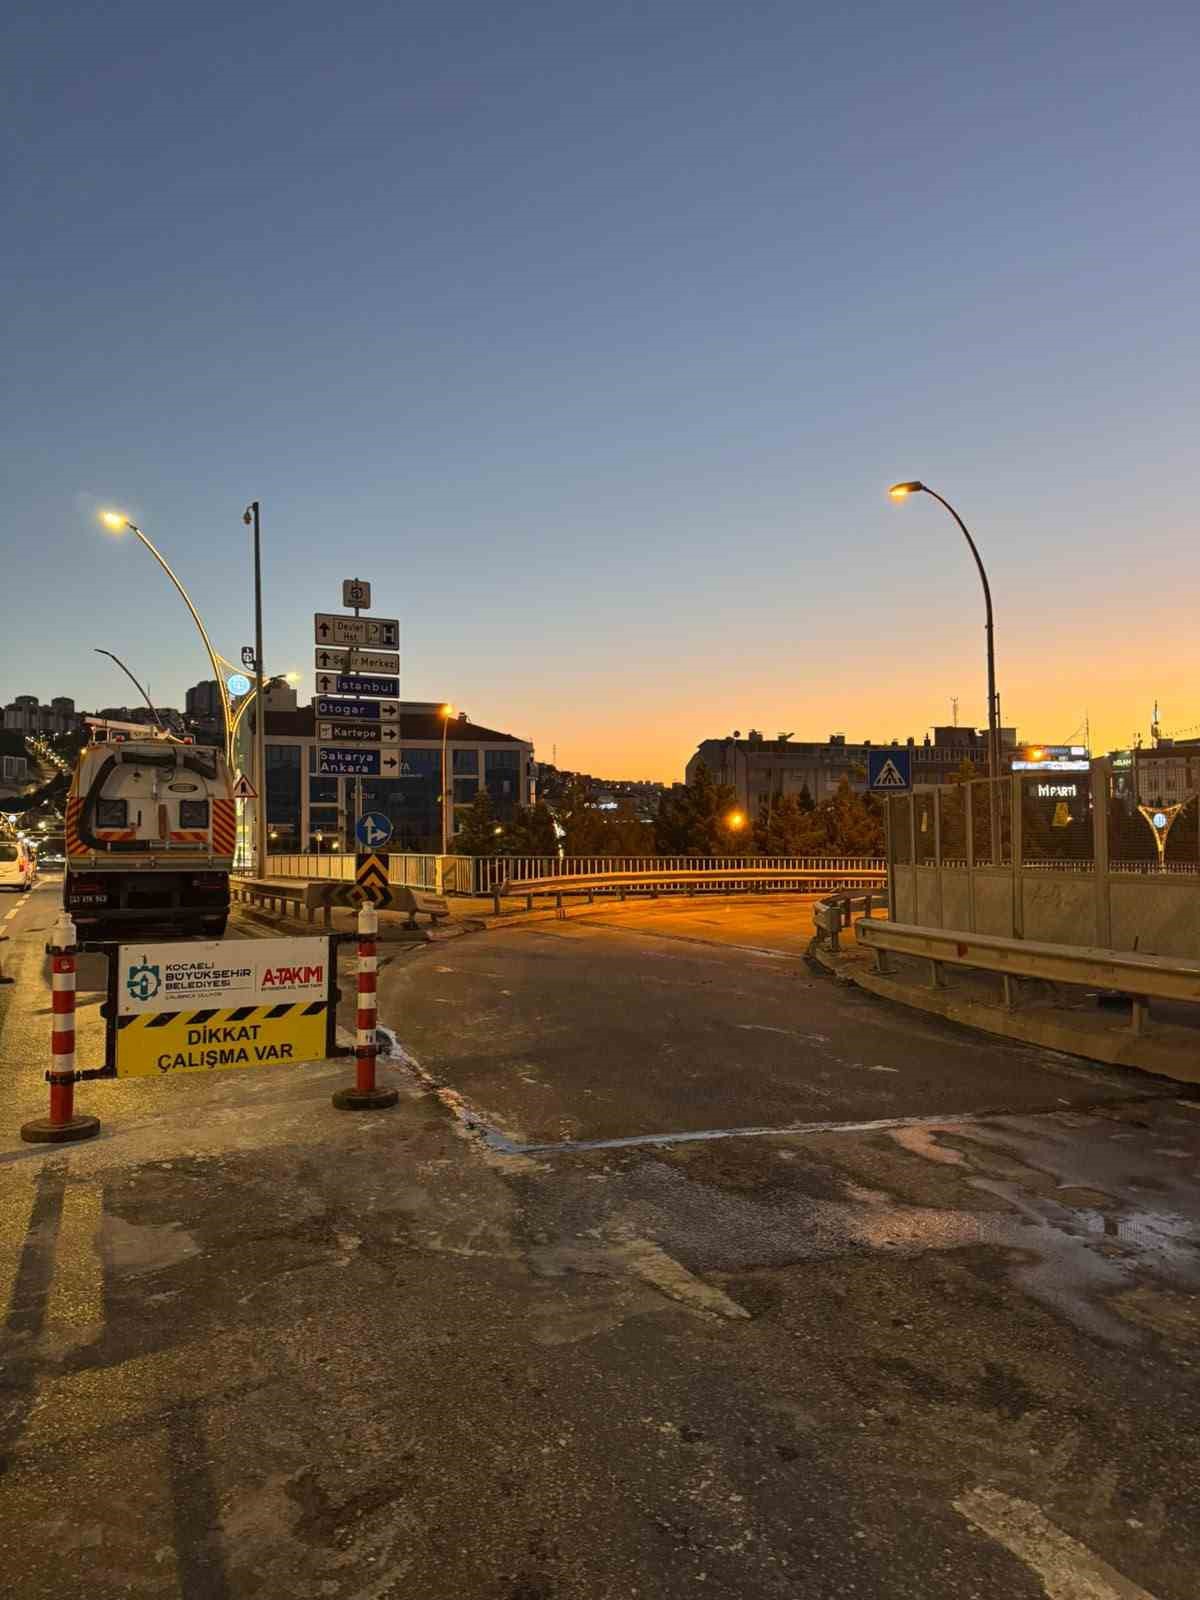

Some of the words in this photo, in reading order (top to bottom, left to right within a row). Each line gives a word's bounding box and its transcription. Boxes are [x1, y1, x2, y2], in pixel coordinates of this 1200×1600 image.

[334, 727, 376, 739] Kartepe
[319, 750, 375, 763] Sakarya
[320, 762, 369, 773] Ankara
[261, 966, 323, 986] A-TAKIMI
[187, 1024, 262, 1046] DİKKAT
[254, 1043, 293, 1061] VAR
